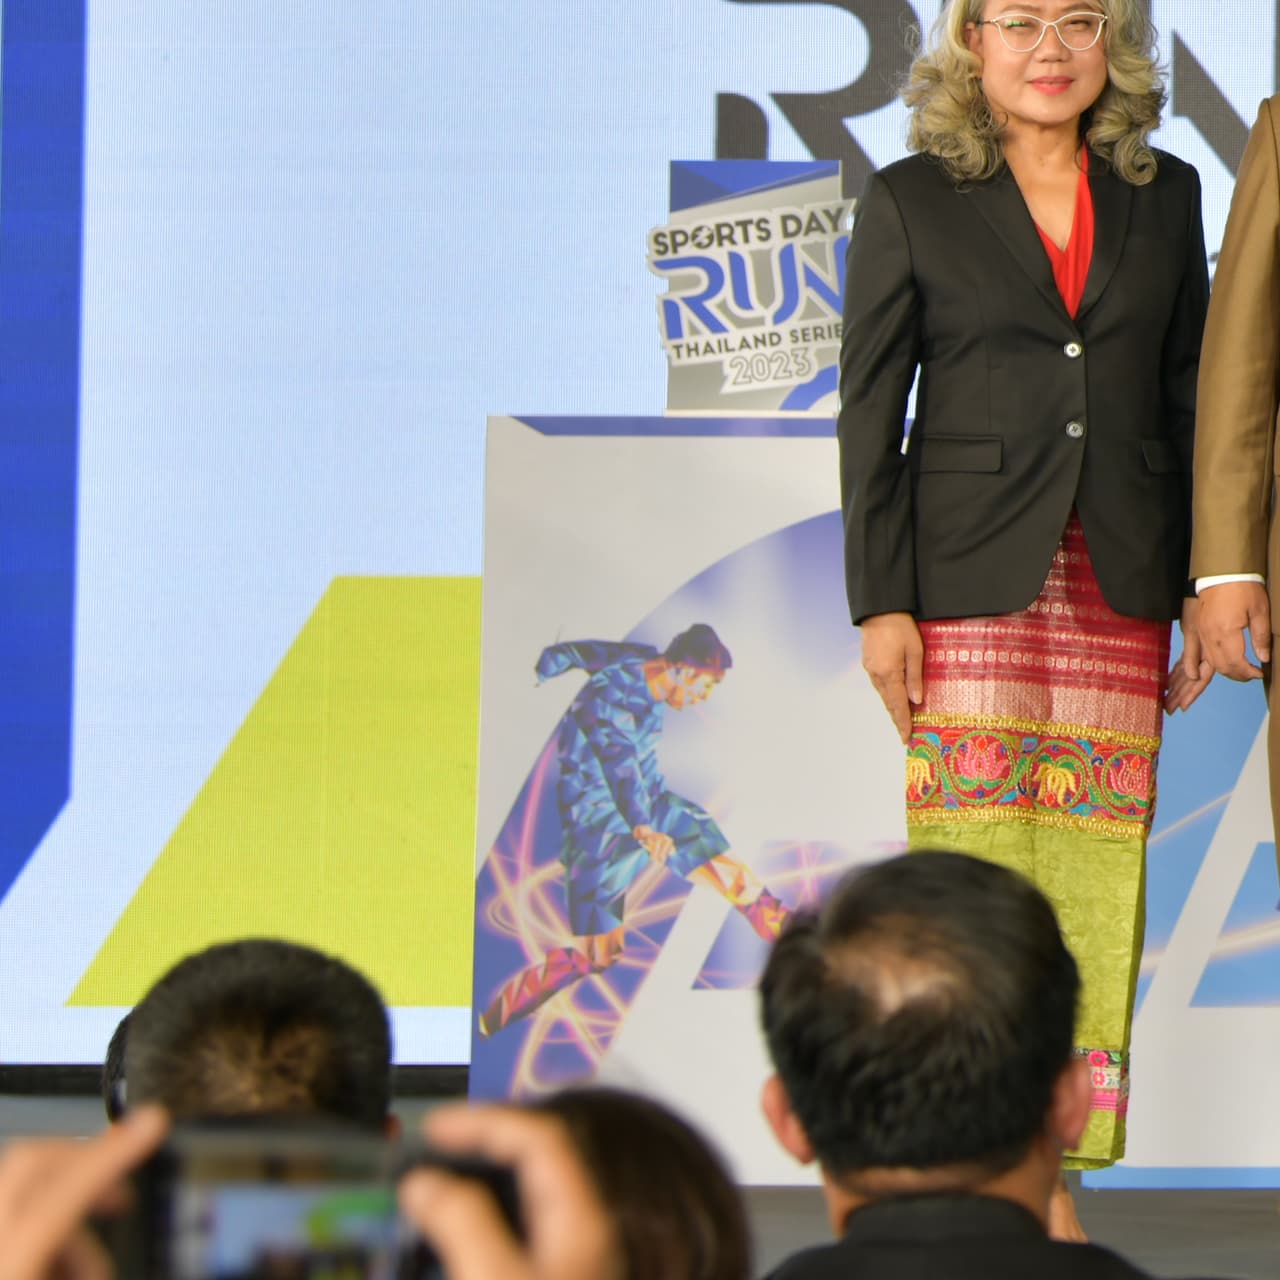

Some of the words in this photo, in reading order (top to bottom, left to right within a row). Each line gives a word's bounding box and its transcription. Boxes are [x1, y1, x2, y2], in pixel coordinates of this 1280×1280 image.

[652, 217, 773, 256] SPORTS
[780, 207, 844, 240] DAY
[652, 235, 849, 342] RUN
[672, 330, 783, 361] THAILAND
[789, 322, 843, 345] SERIE
[729, 346, 812, 387] 2023
